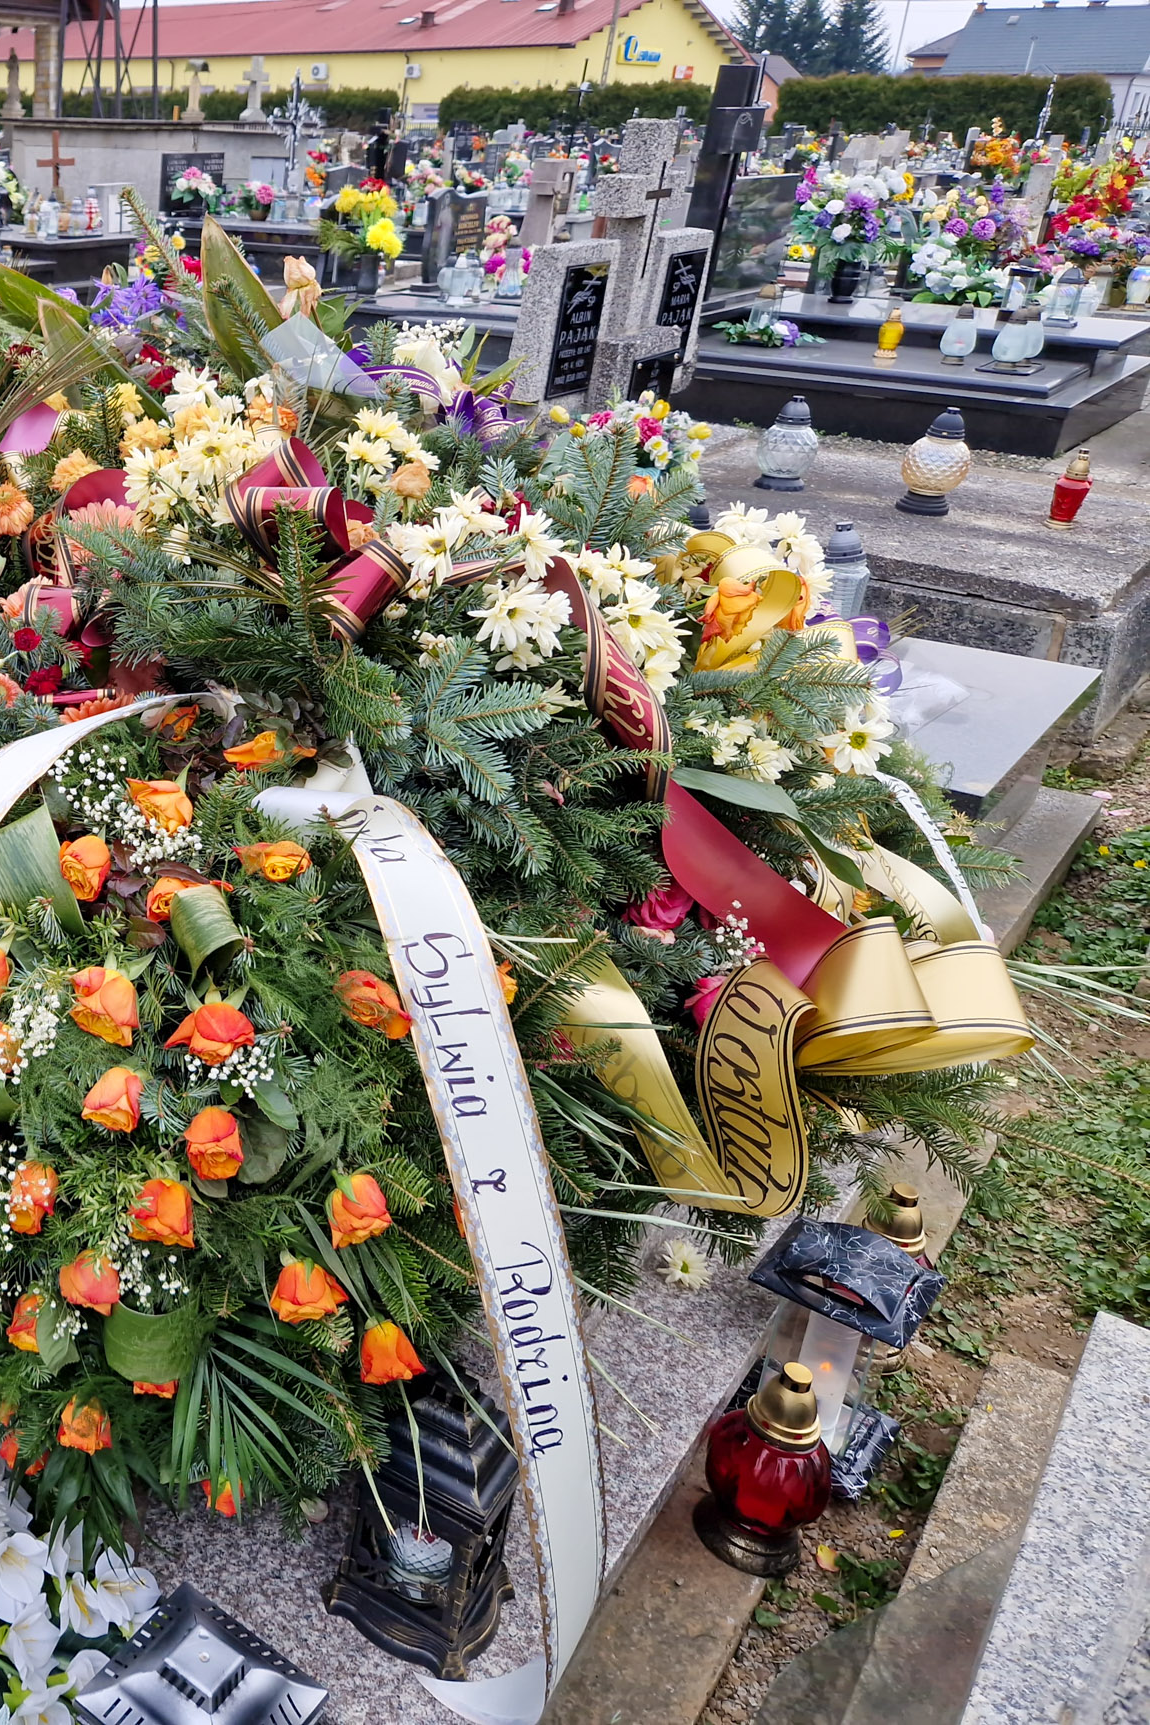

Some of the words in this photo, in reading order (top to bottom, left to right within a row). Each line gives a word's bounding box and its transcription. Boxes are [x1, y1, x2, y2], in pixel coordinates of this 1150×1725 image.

[670, 293, 690, 306] MARIA
[570, 310, 592, 324] ALBIN
[401, 931, 494, 1119] Sylwia
